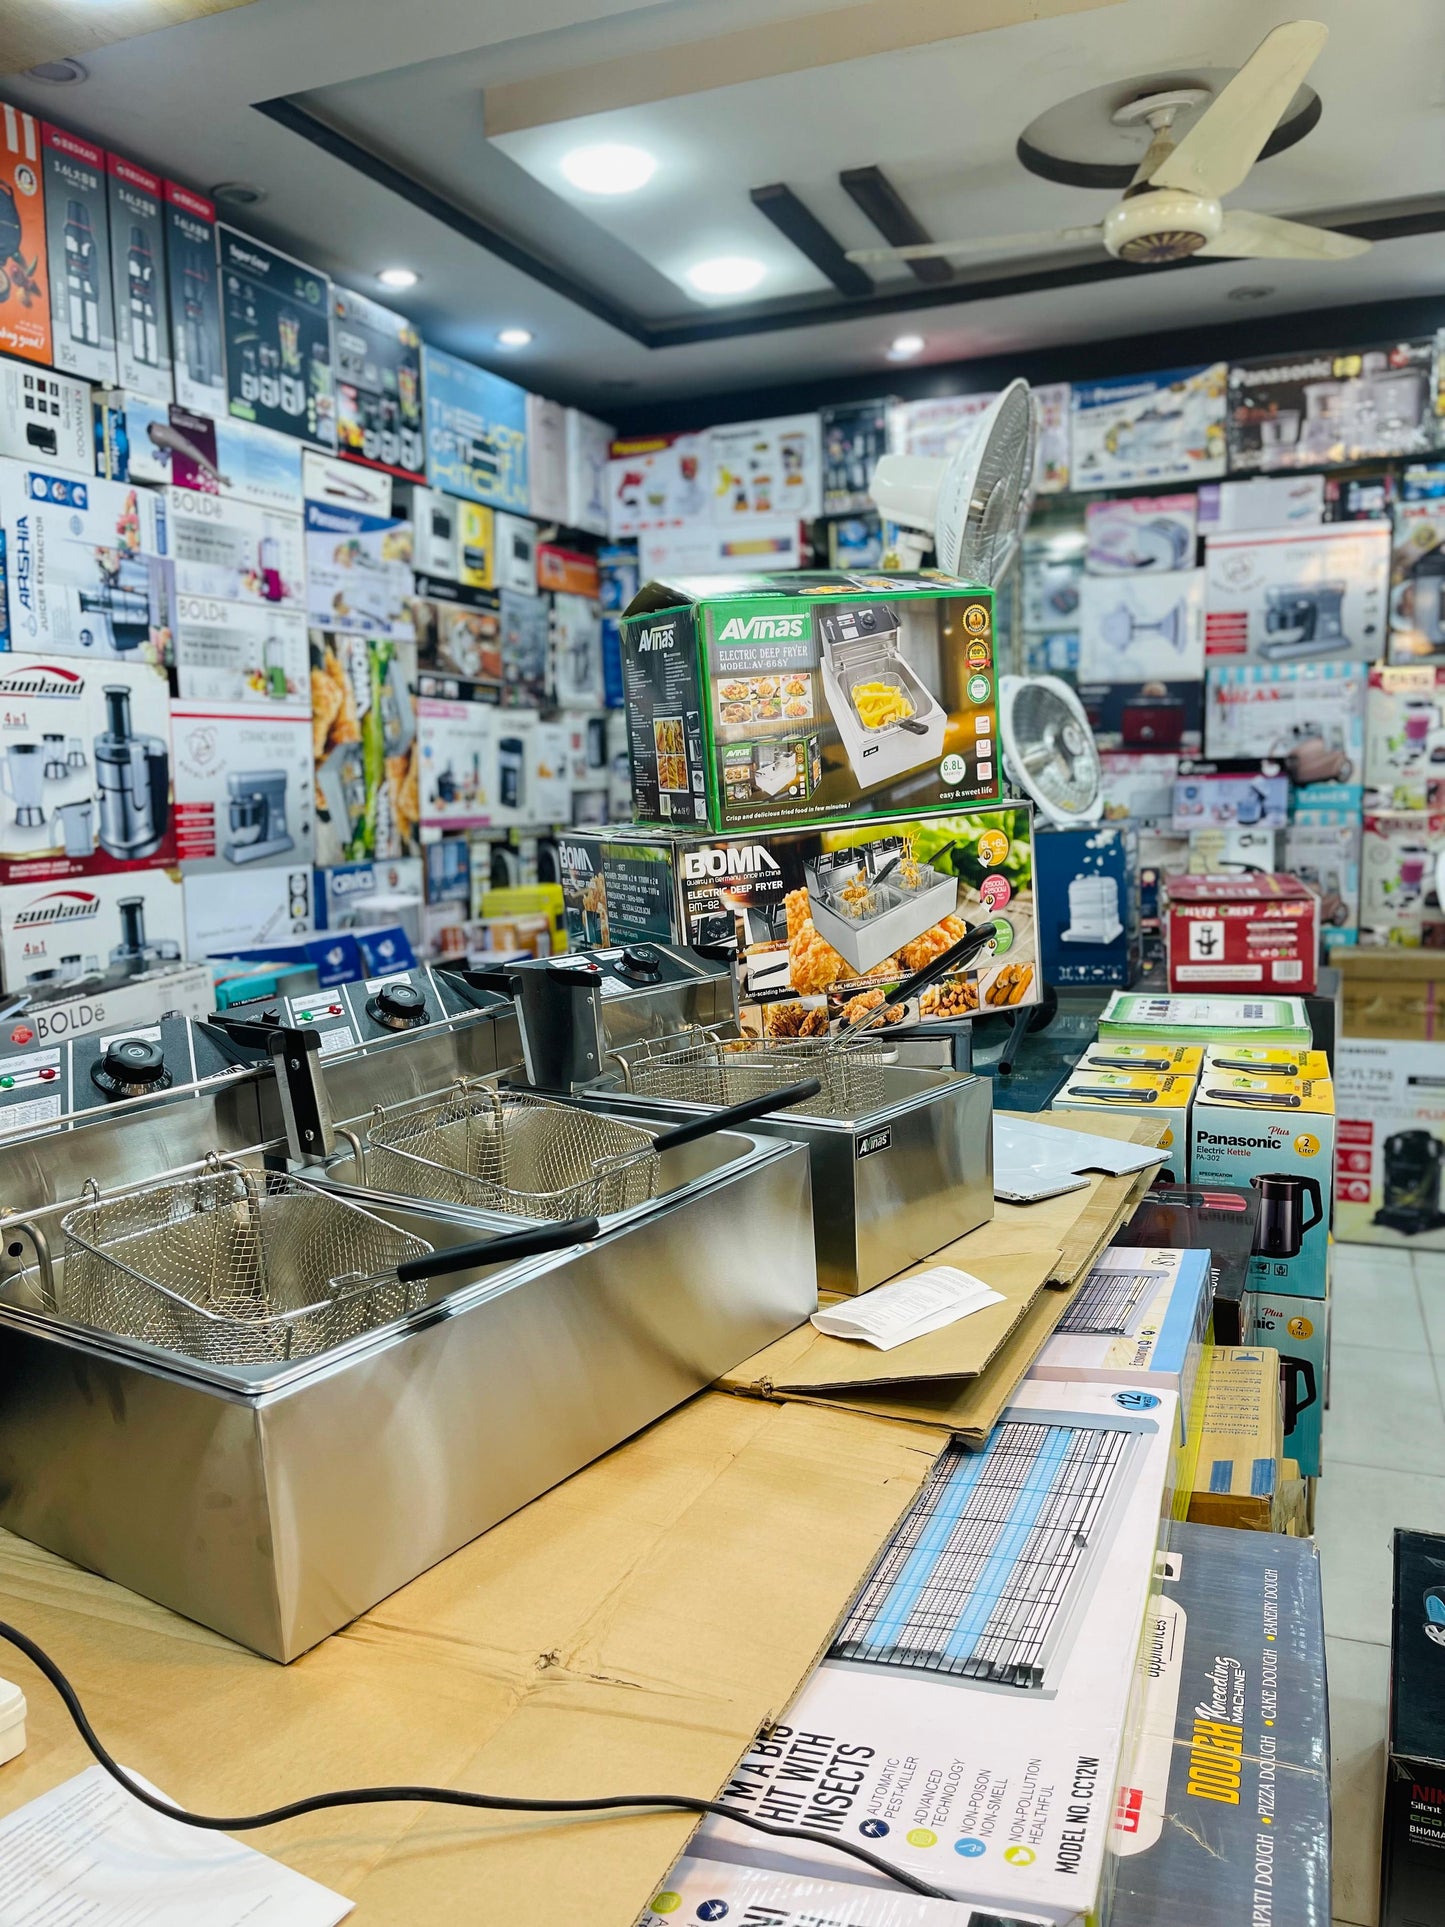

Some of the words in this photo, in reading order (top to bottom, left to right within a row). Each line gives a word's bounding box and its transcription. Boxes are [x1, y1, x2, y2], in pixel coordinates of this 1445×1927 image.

[74, 389, 85, 458] KENWOOD
[16, 515, 31, 610] ARSHIA
[36, 516, 46, 585] EXTRACTOR
[38, 587, 47, 631] JUICER
[719, 649, 757, 661] ELECTRIC
[760, 647, 780, 659] DEEP
[783, 645, 808, 657] FRYER
[4, 712, 11, 726] 4
[943, 758, 962, 771] 6.8L
[940, 791, 954, 799] easy
[955, 789, 961, 797] &
[962, 788, 980, 797] sweet
[981, 786, 993, 795] life
[754, 811, 780, 819] delicious
[684, 845, 781, 879] BOMA
[688, 887, 728, 900] ELECTRIC
[731, 884, 752, 894] DEEP
[756, 880, 783, 892] FRYER
[688, 900, 720, 912] BM-82
[15, 898, 101, 925] sunland
[24, 942, 32, 954] 4
[745, 990, 778, 999] Anti-scalding
[37, 1003, 105, 1039] BOLDë
[1196, 1130, 1282, 1150] Panasonic
[1268, 1126, 1290, 1136] Plus
[1304, 1138, 1310, 1147] 2
[1196, 1154, 1220, 1162] PA-302
[1197, 1146, 1225, 1155] Electric
[1227, 1147, 1252, 1157] Kettle
[1262, 1307, 1284, 1318] Plus
[1297, 1321, 1304, 1330] 2
[1116, 1394, 1142, 1406] 12
[1264, 1568, 1278, 1600] DOUGH
[1264, 1598, 1278, 1636] BAKERY
[1262, 1648, 1278, 1688] DOUGH
[1195, 1656, 1242, 1721] Kneading
[1232, 1668, 1246, 1724] MACHINE
[1262, 1690, 1277, 1720] CAKE
[740, 1764, 775, 1778] A
[775, 1732, 836, 1782] WITH
[1187, 1718, 1244, 1805] DOUGH
[1261, 1735, 1276, 1781] DOUGH
[800, 1743, 876, 1832] INSECTS
[868, 1757, 900, 1816] AUTOMATIC
[884, 1756, 920, 1820] PEST-KILLER
[930, 1758, 966, 1828] TECHNOLOGY
[1071, 1756, 1100, 1800] CC12W
[754, 1784, 807, 1823] HIT
[913, 1768, 943, 1826] ADVANCED
[960, 1768, 992, 1834] NON-POISON
[978, 1778, 1008, 1838] NON-SMELL
[1008, 1758, 1042, 1842] NON-POLLUTION
[1066, 1802, 1092, 1825] NO.
[1258, 1784, 1276, 1818] PIZZA
[1410, 1800, 1442, 1814] Silent
[1028, 1784, 1054, 1846] HEALTHFUL
[1055, 1828, 1086, 1875] MODEL
[1256, 1833, 1274, 1888] DOUGH
